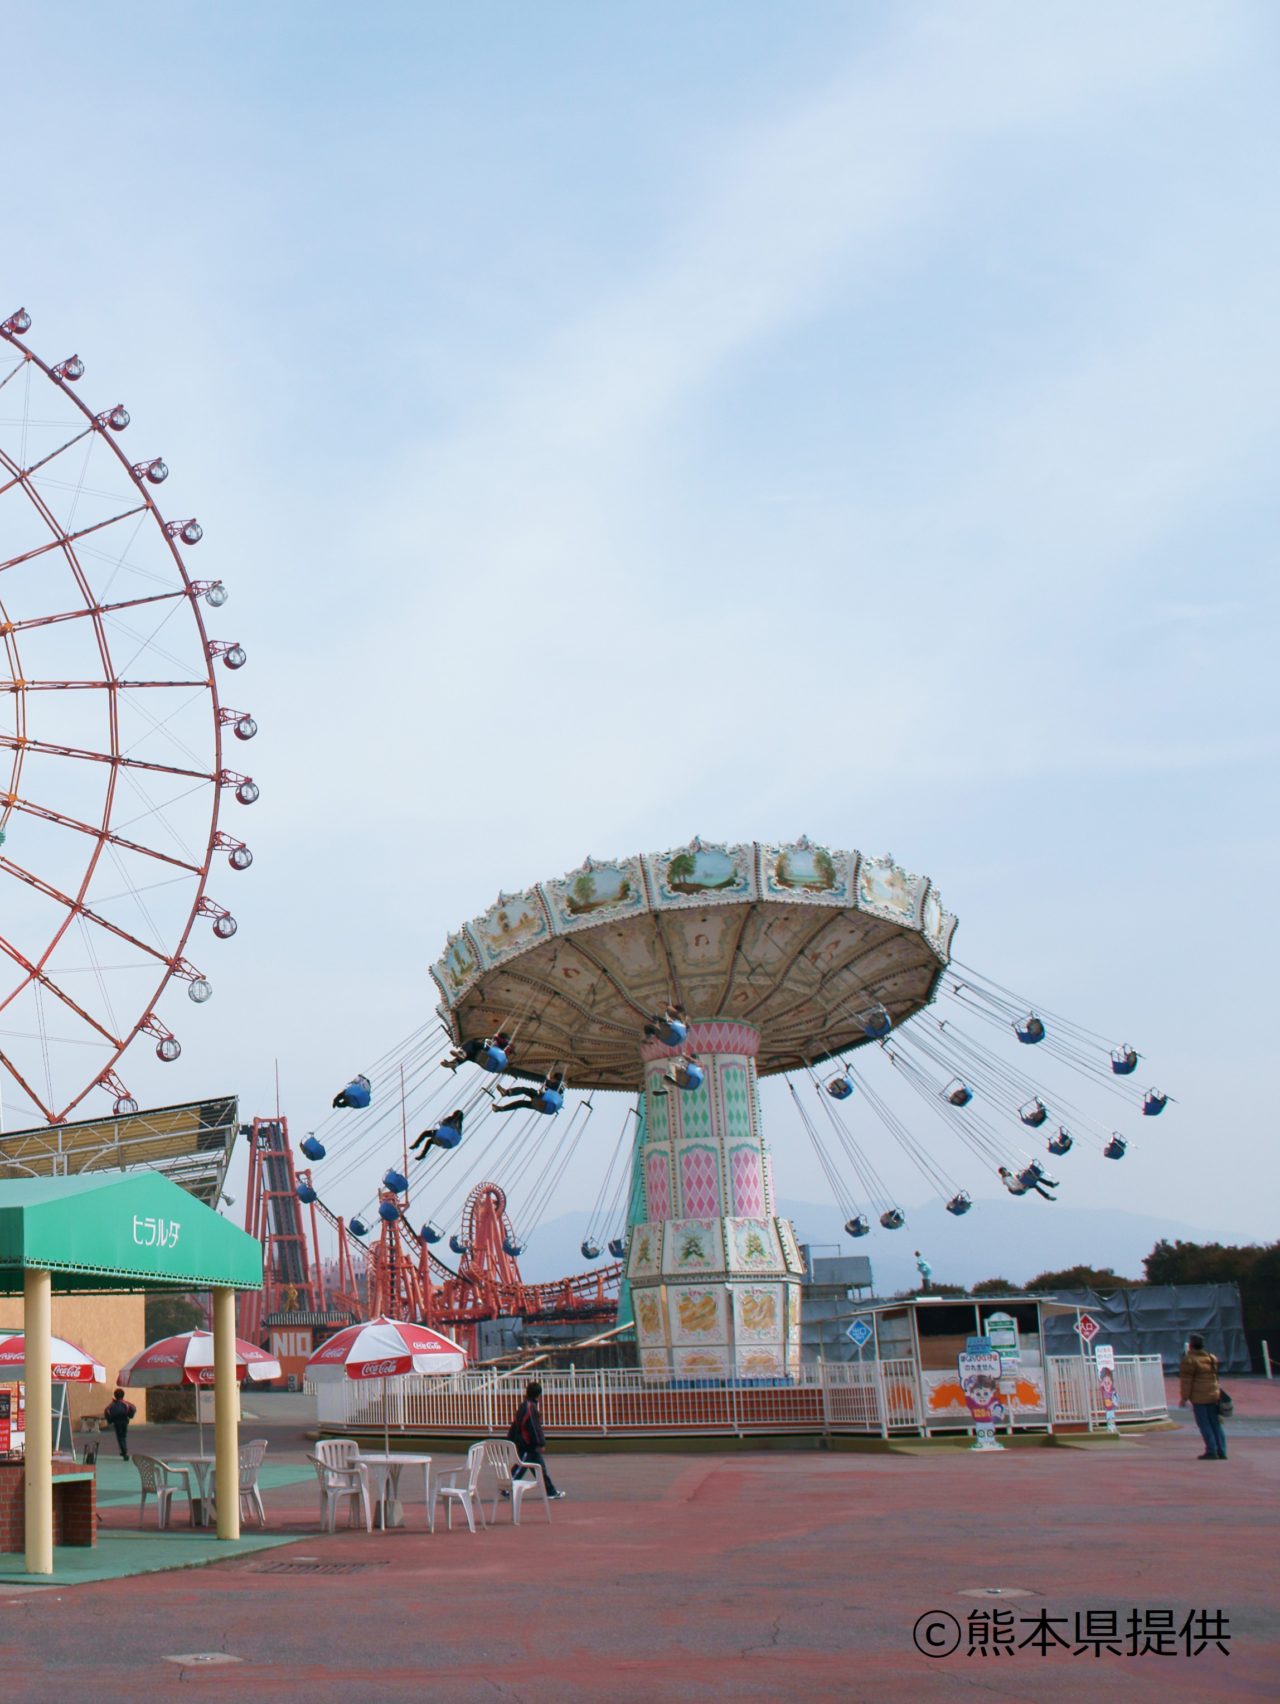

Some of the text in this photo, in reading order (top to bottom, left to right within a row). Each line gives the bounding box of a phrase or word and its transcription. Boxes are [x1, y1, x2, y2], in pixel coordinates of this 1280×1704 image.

[133, 1214, 181, 1248] ヒラルダ
[412, 1341, 441, 1351] Coca-Cola
[52, 1364, 81, 1378] Coca-Cola
[361, 1360, 397, 1376] Coca-Cola
